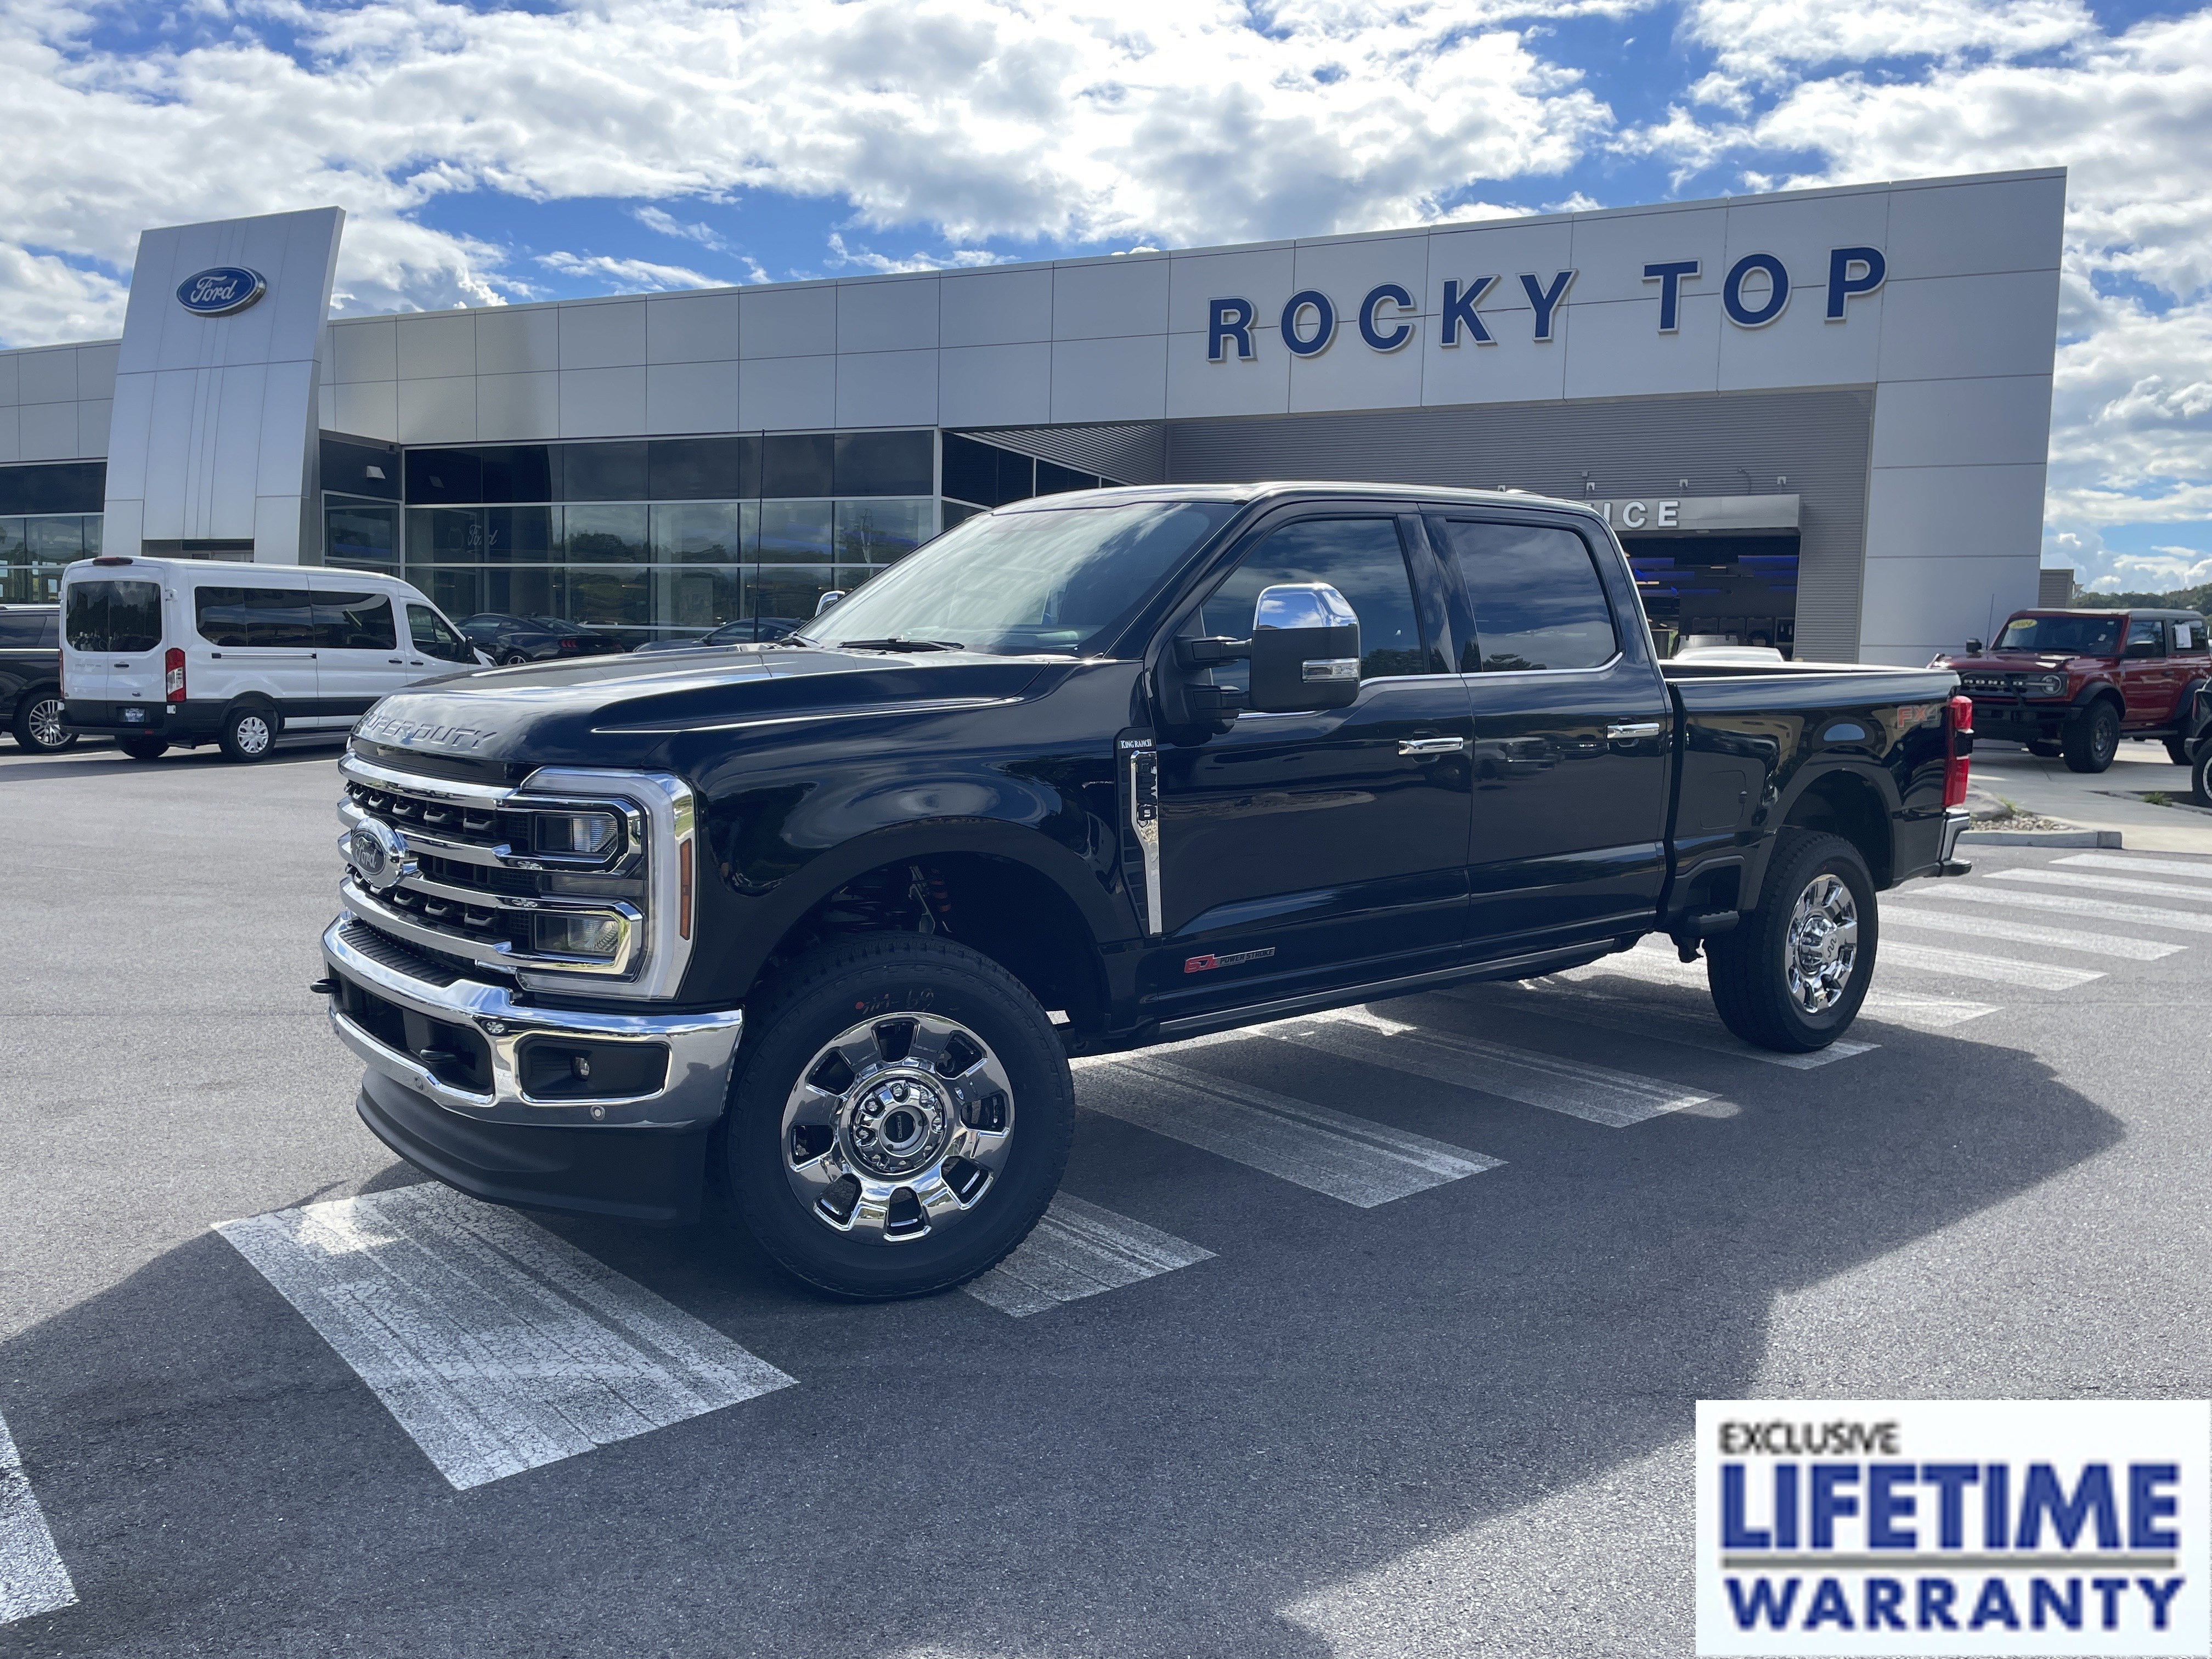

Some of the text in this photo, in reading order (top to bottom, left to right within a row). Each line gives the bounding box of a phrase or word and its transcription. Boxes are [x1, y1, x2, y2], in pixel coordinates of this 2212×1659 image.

[190, 275, 238, 303] Ford
[1207, 245, 1888, 362] ROCKY TOP
[1585, 500, 1680, 528] ICE
[1897, 704, 1942, 729] FX4
[360, 713, 497, 749] UPER DUTY
[1121, 738, 1152, 748] KING RANCH
[356, 836, 377, 868] Ford
[1220, 953, 1245, 964] POWER
[1246, 949, 1274, 960] STROKE
